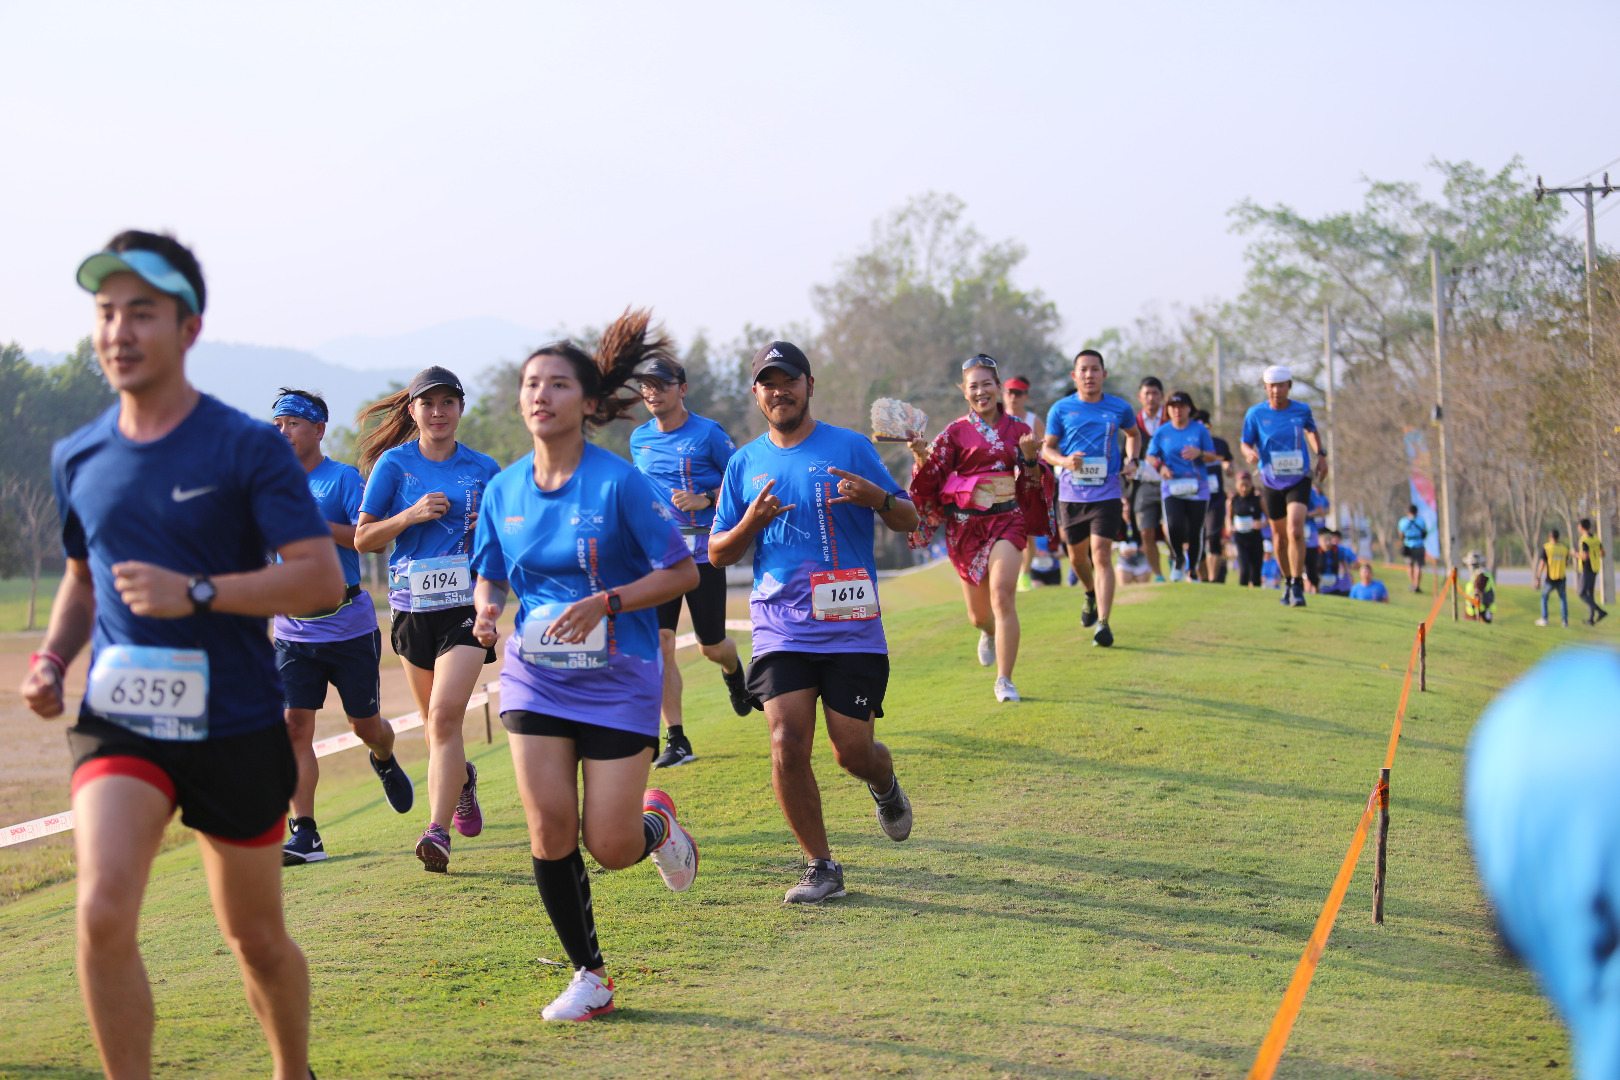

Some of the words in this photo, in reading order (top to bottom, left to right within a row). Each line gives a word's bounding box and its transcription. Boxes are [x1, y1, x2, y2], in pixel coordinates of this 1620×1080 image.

[824, 482, 832, 514] SINGHA
[817, 508, 828, 544] COUNTRY
[826, 515, 836, 538] PARK
[822, 545, 830, 562] RUN
[422, 571, 458, 590] 6194
[831, 586, 865, 602] 1616
[111, 678, 187, 707] 6359
